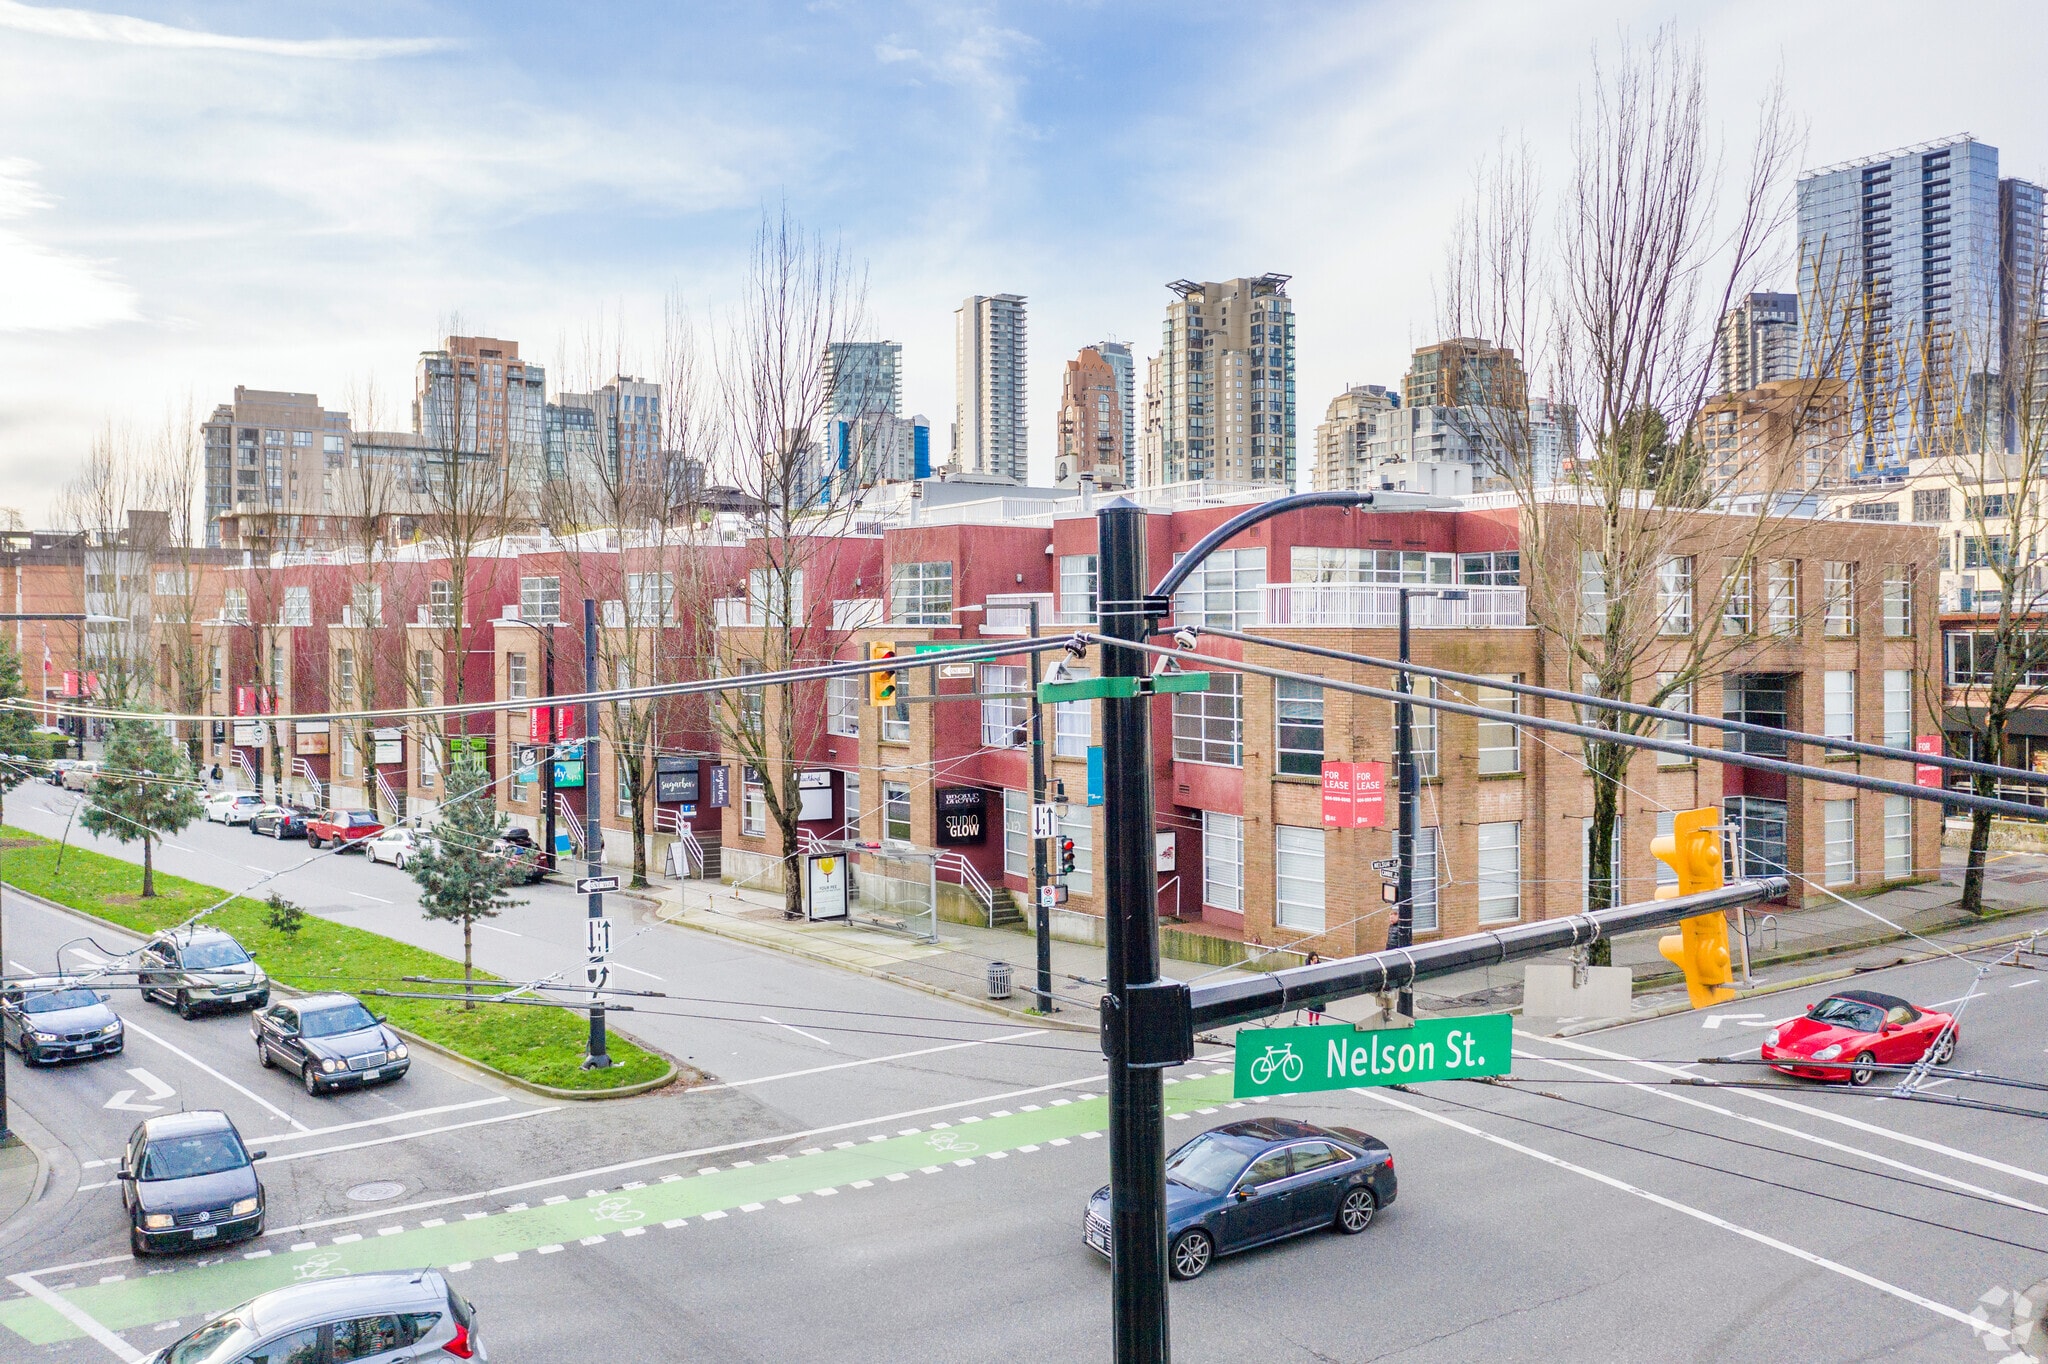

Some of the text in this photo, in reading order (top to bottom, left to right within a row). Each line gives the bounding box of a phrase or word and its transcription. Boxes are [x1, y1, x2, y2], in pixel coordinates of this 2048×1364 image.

[1918, 742, 1931, 752] FOR
[1324, 770, 1340, 780] FOR
[1356, 772, 1371, 781] FOR
[1324, 780, 1350, 790] LEASE
[1356, 781, 1381, 791] LEASE
[945, 814, 979, 829] STUDIO
[949, 824, 980, 838] GLOW
[1327, 1030, 1485, 1078] Nelson St.
